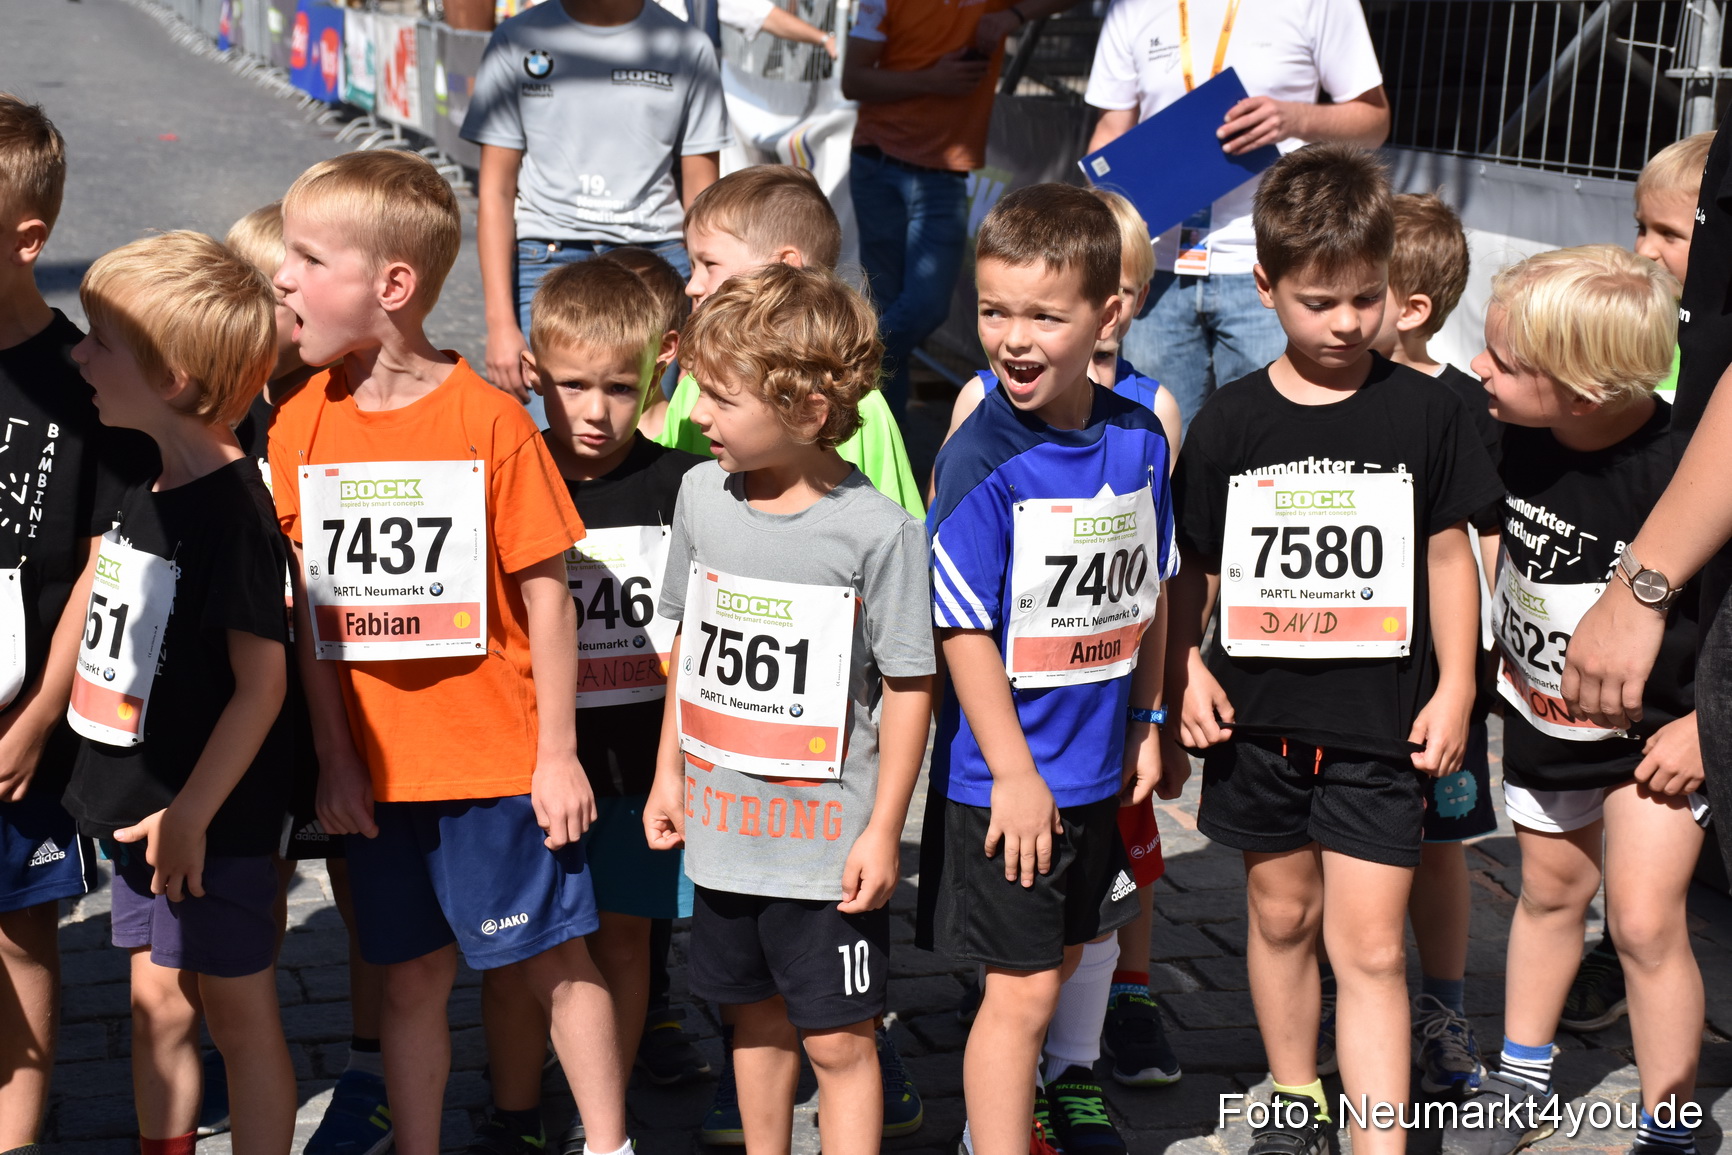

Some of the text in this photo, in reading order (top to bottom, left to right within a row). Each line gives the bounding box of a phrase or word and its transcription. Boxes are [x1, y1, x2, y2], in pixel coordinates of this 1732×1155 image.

[611, 69, 673, 86] BOCK
[579, 174, 611, 196] 19.
[28, 423, 59, 538] BAMBINI
[340, 479, 423, 500] BOCK
[340, 501, 361, 509] inspired
[1275, 490, 1355, 509] BOCK
[1074, 511, 1136, 537] BOCK
[323, 517, 452, 575] 7437
[1251, 525, 1383, 579] 7580
[1045, 543, 1148, 608] 7400
[1229, 568, 1241, 578] B5
[334, 586, 424, 597] PARTL Neumarkt
[1261, 589, 1355, 600] PARTL Neumarkt
[717, 589, 793, 620] BOCK
[1020, 599, 1033, 609] B2
[346, 612, 420, 635] Fabian
[716, 609, 733, 619] inspired
[743, 616, 761, 624] smart
[763, 619, 793, 627] concepts
[1051, 610, 1130, 628] PARTL Neumarkt
[1260, 612, 1337, 634] DAVID
[1501, 590, 1573, 676] 7523
[699, 621, 809, 695] 7561
[1070, 639, 1121, 664] Anton
[577, 658, 661, 687] ANDER
[700, 688, 784, 715] PARTL Neumarkt
[701, 786, 843, 841] STRONG
[295, 832, 330, 841] adidas
[28, 851, 65, 866] adidas
[1111, 881, 1137, 901] adidas
[499, 913, 529, 930] JAKO
[838, 940, 870, 996] 10
